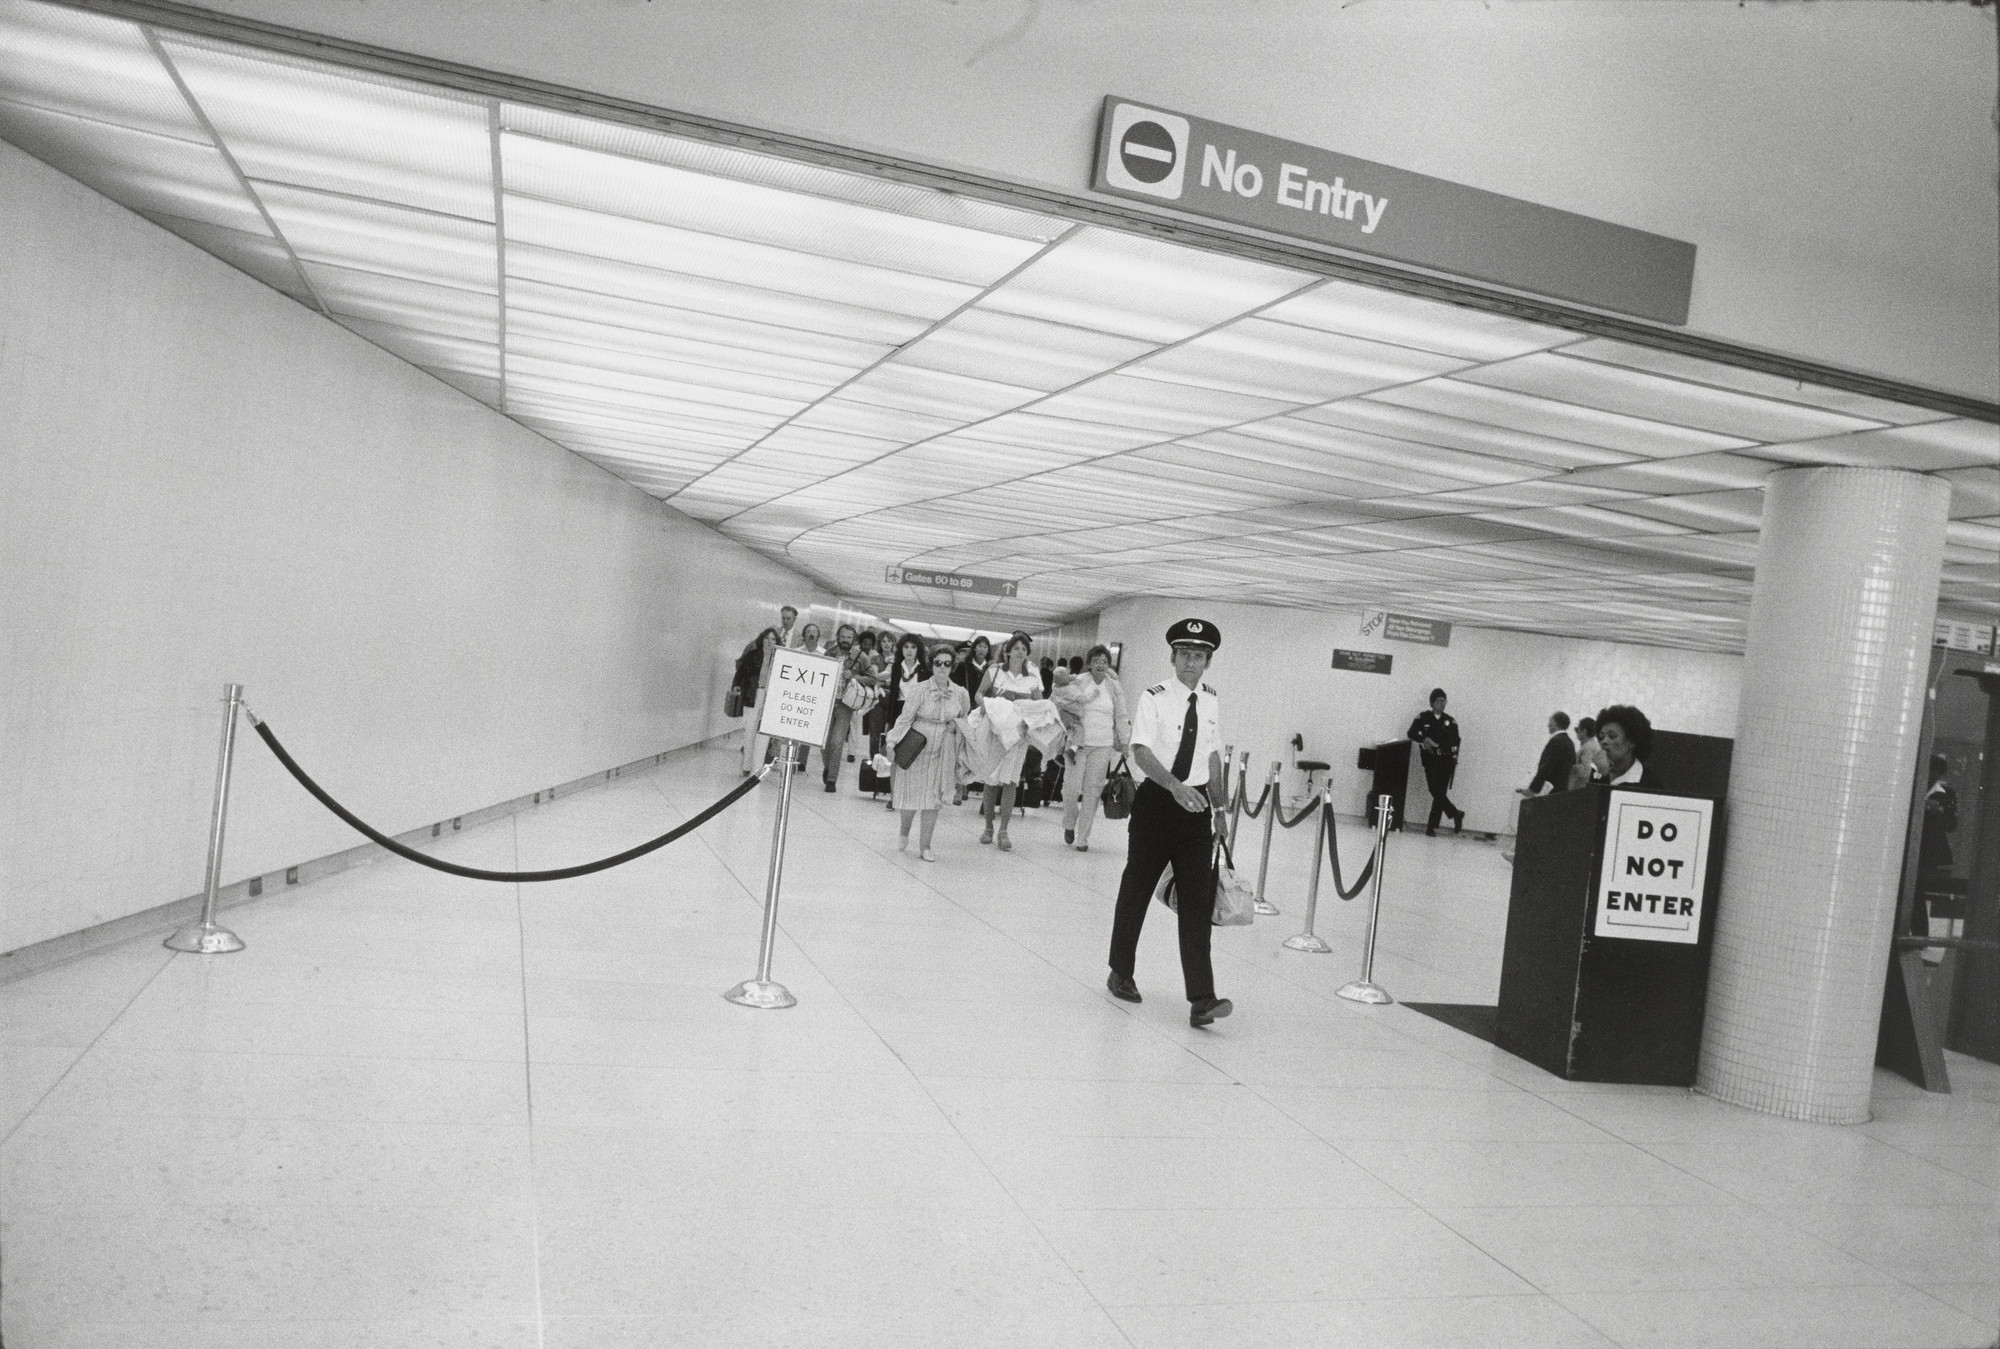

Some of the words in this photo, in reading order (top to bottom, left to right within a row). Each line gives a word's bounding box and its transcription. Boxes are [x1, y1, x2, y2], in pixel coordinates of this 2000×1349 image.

[1200, 144, 1263, 198] No
[1276, 162, 1389, 234] Entry
[905, 572, 932, 584] Gates
[949, 577, 959, 586] to
[1361, 611, 1384, 637] STOP
[780, 665, 829, 687] EXIT
[782, 690, 818, 705] PLEASE
[780, 702, 793, 712] DO
[796, 706, 814, 716] NOT
[780, 715, 810, 729] ENTER
[1637, 820, 1678, 842] DO
[1625, 855, 1684, 879] NOT
[1606, 890, 1695, 917] ENTER
